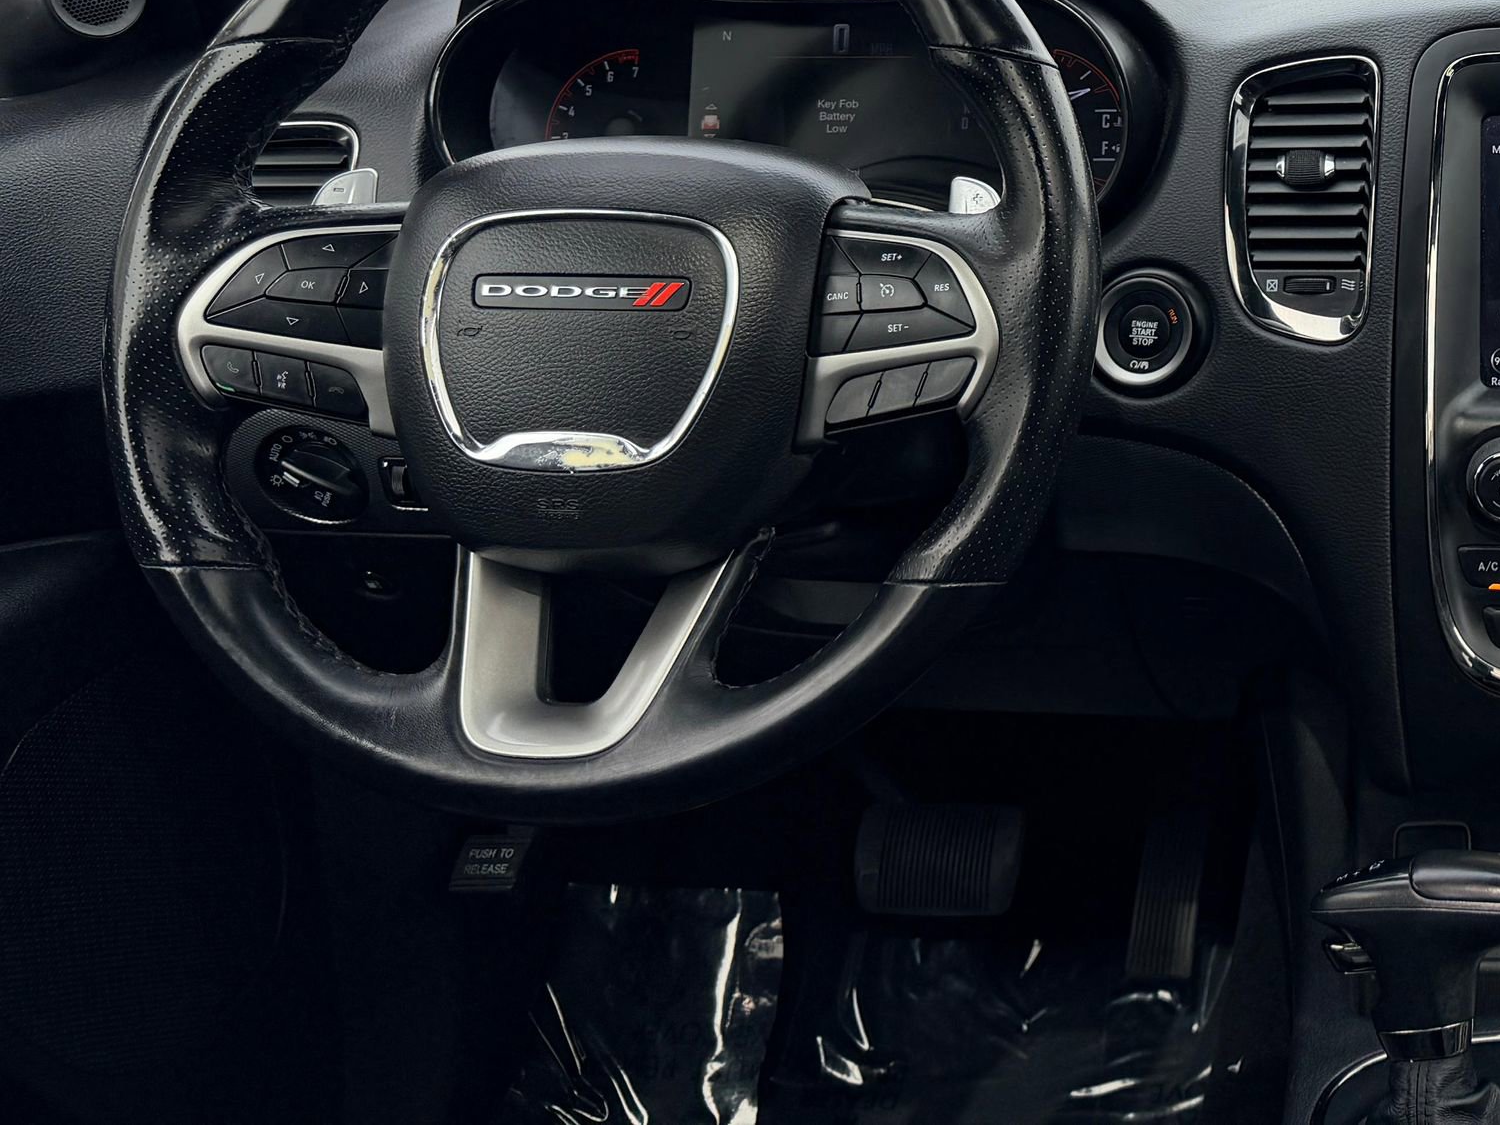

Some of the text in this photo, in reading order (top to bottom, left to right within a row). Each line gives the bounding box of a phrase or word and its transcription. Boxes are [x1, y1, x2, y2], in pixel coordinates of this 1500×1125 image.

[722, 30, 732, 41] N
[606, 71, 614, 83] 6
[631, 66, 640, 78] 7
[585, 85, 593, 96] 5
[817, 99, 859, 110] Key Fob
[568, 105, 575, 117] 4
[819, 111, 855, 123] Battery
[1101, 114, 1110, 128] C
[826, 124, 848, 133] Low
[1101, 141, 1109, 155] F
[301, 280, 315, 289] OK
[934, 283, 950, 292] RES
[480, 283, 649, 298] DODGE
[827, 292, 849, 301] CANC
[1131, 320, 1159, 329] ENGINE
[1132, 328, 1156, 336] START
[1132, 338, 1154, 346] STOP
[269, 443, 283, 462] AUTO
[536, 498, 579, 509] SRS
[1478, 562, 1499, 572] A/C
[468, 848, 514, 859] PUSH TO
[463, 863, 509, 874] RELEASE
